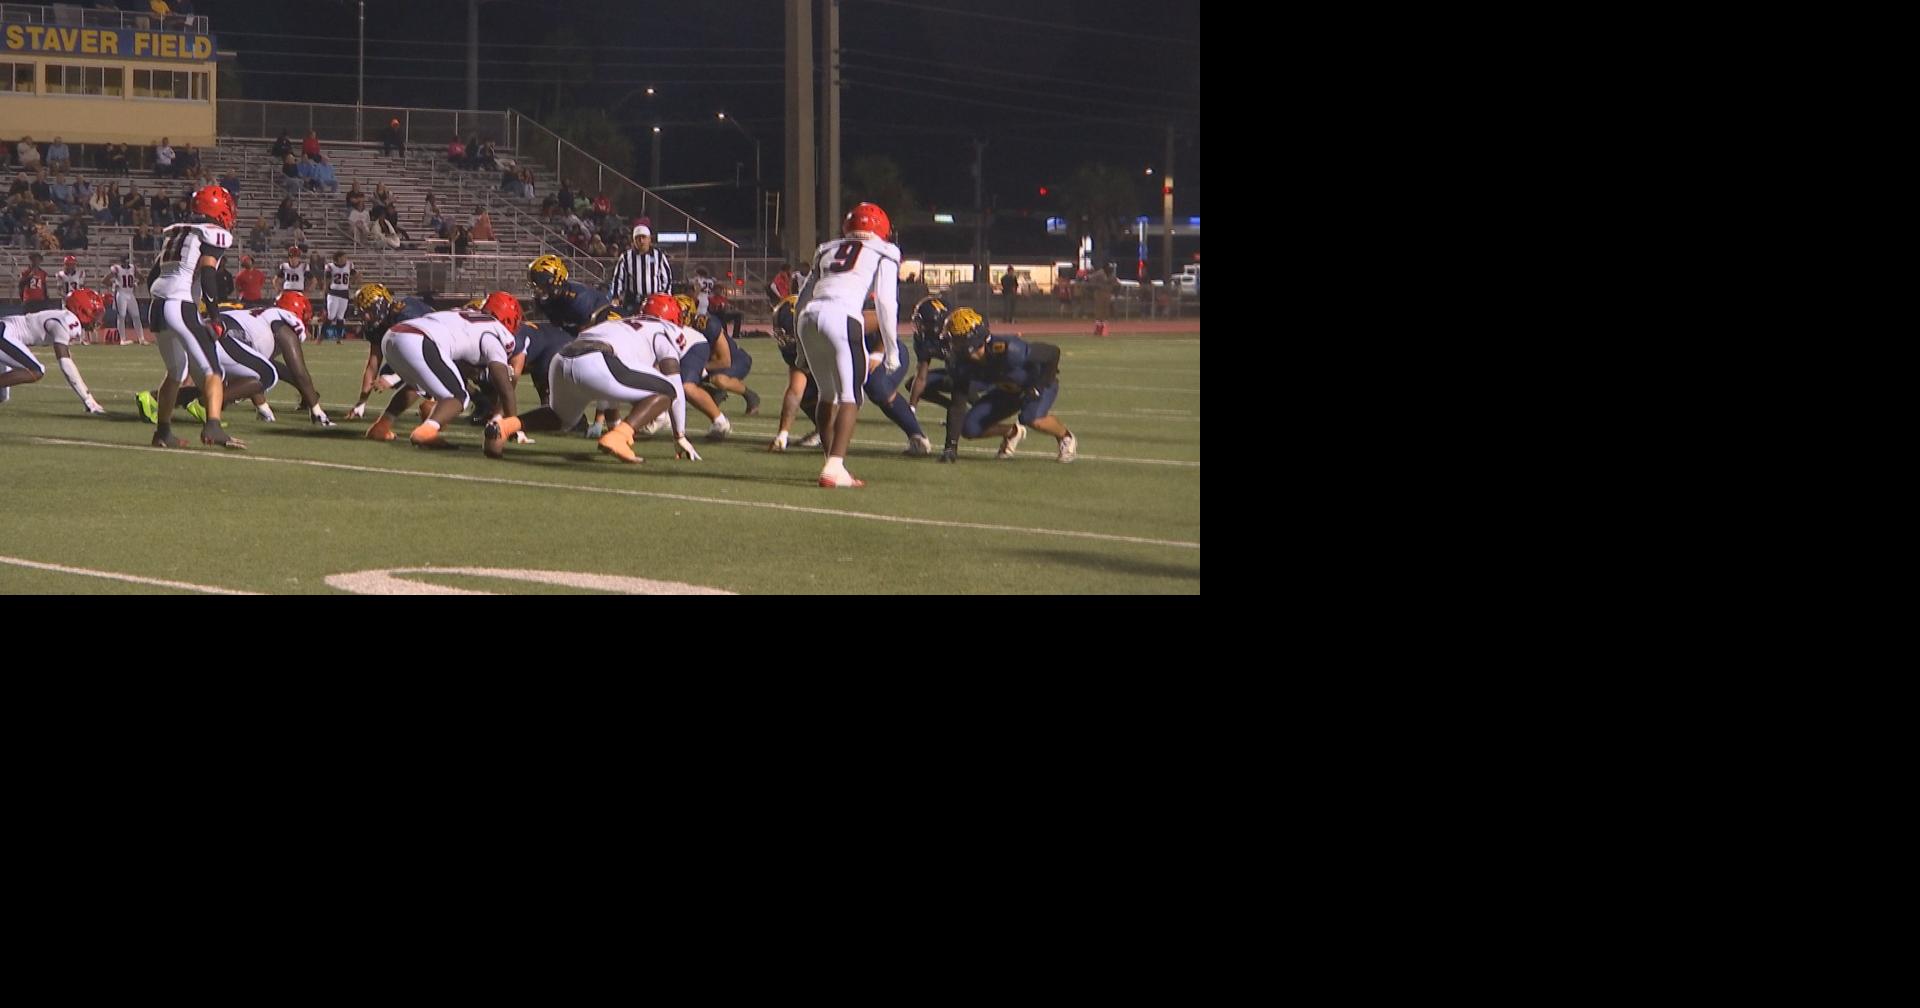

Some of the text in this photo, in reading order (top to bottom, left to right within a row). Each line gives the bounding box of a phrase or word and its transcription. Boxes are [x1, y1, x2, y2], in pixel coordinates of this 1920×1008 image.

[6, 25, 212, 59] STAVER FIELD
[215, 232, 226, 246] 11
[829, 240, 863, 273] 9
[121, 274, 134, 288] 10
[333, 272, 349, 284] 26
